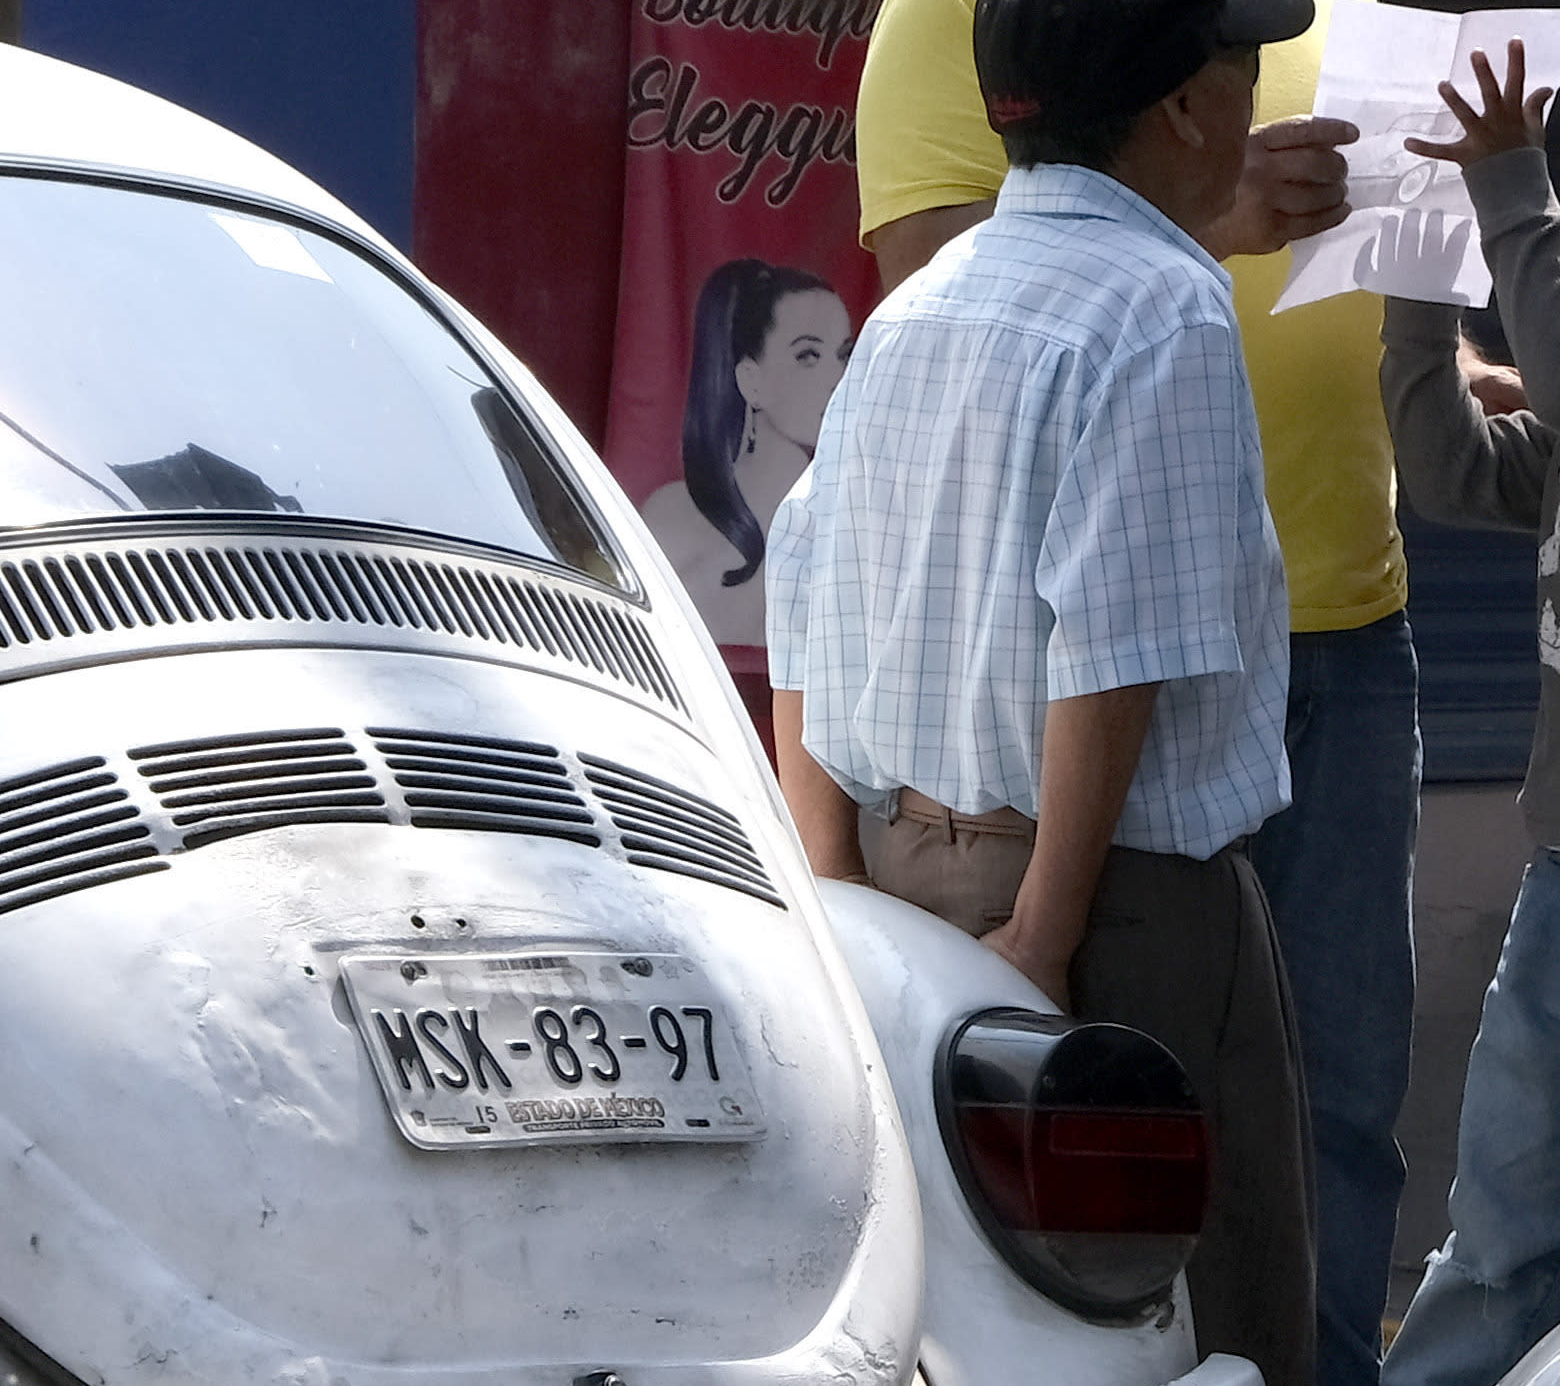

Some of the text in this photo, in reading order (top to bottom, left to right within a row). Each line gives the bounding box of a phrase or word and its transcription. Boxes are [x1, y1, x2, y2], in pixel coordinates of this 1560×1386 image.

[371, 1004, 721, 1091] MSK-83-97
[505, 1098, 576, 1123] ESTADO
[577, 1097, 601, 1119] DE
